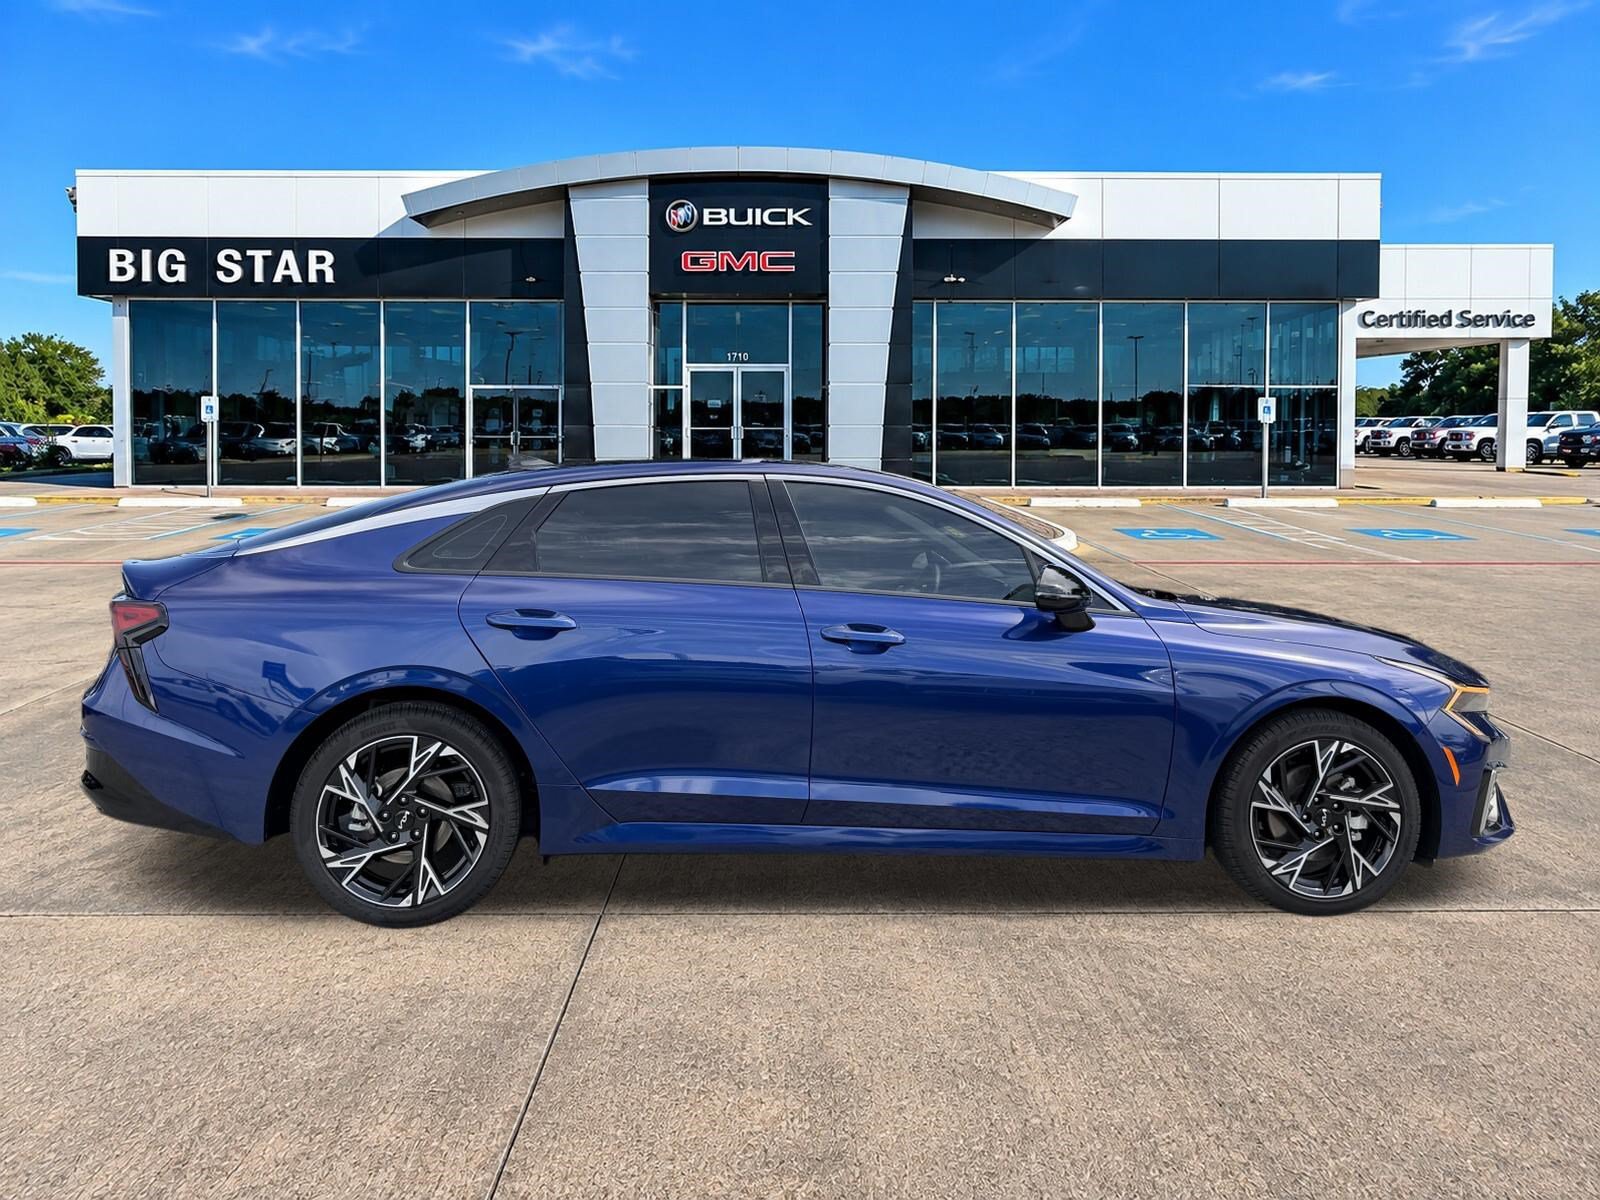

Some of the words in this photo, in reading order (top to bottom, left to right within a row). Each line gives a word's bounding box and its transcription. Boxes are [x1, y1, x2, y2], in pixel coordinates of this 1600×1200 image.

[703, 208, 812, 226] BUICK
[108, 248, 187, 283] BIG
[216, 248, 335, 284] STAR
[681, 250, 796, 272] GMC
[1358, 309, 1452, 328] Certified
[1456, 309, 1536, 328] Service
[727, 352, 749, 361] 1710
